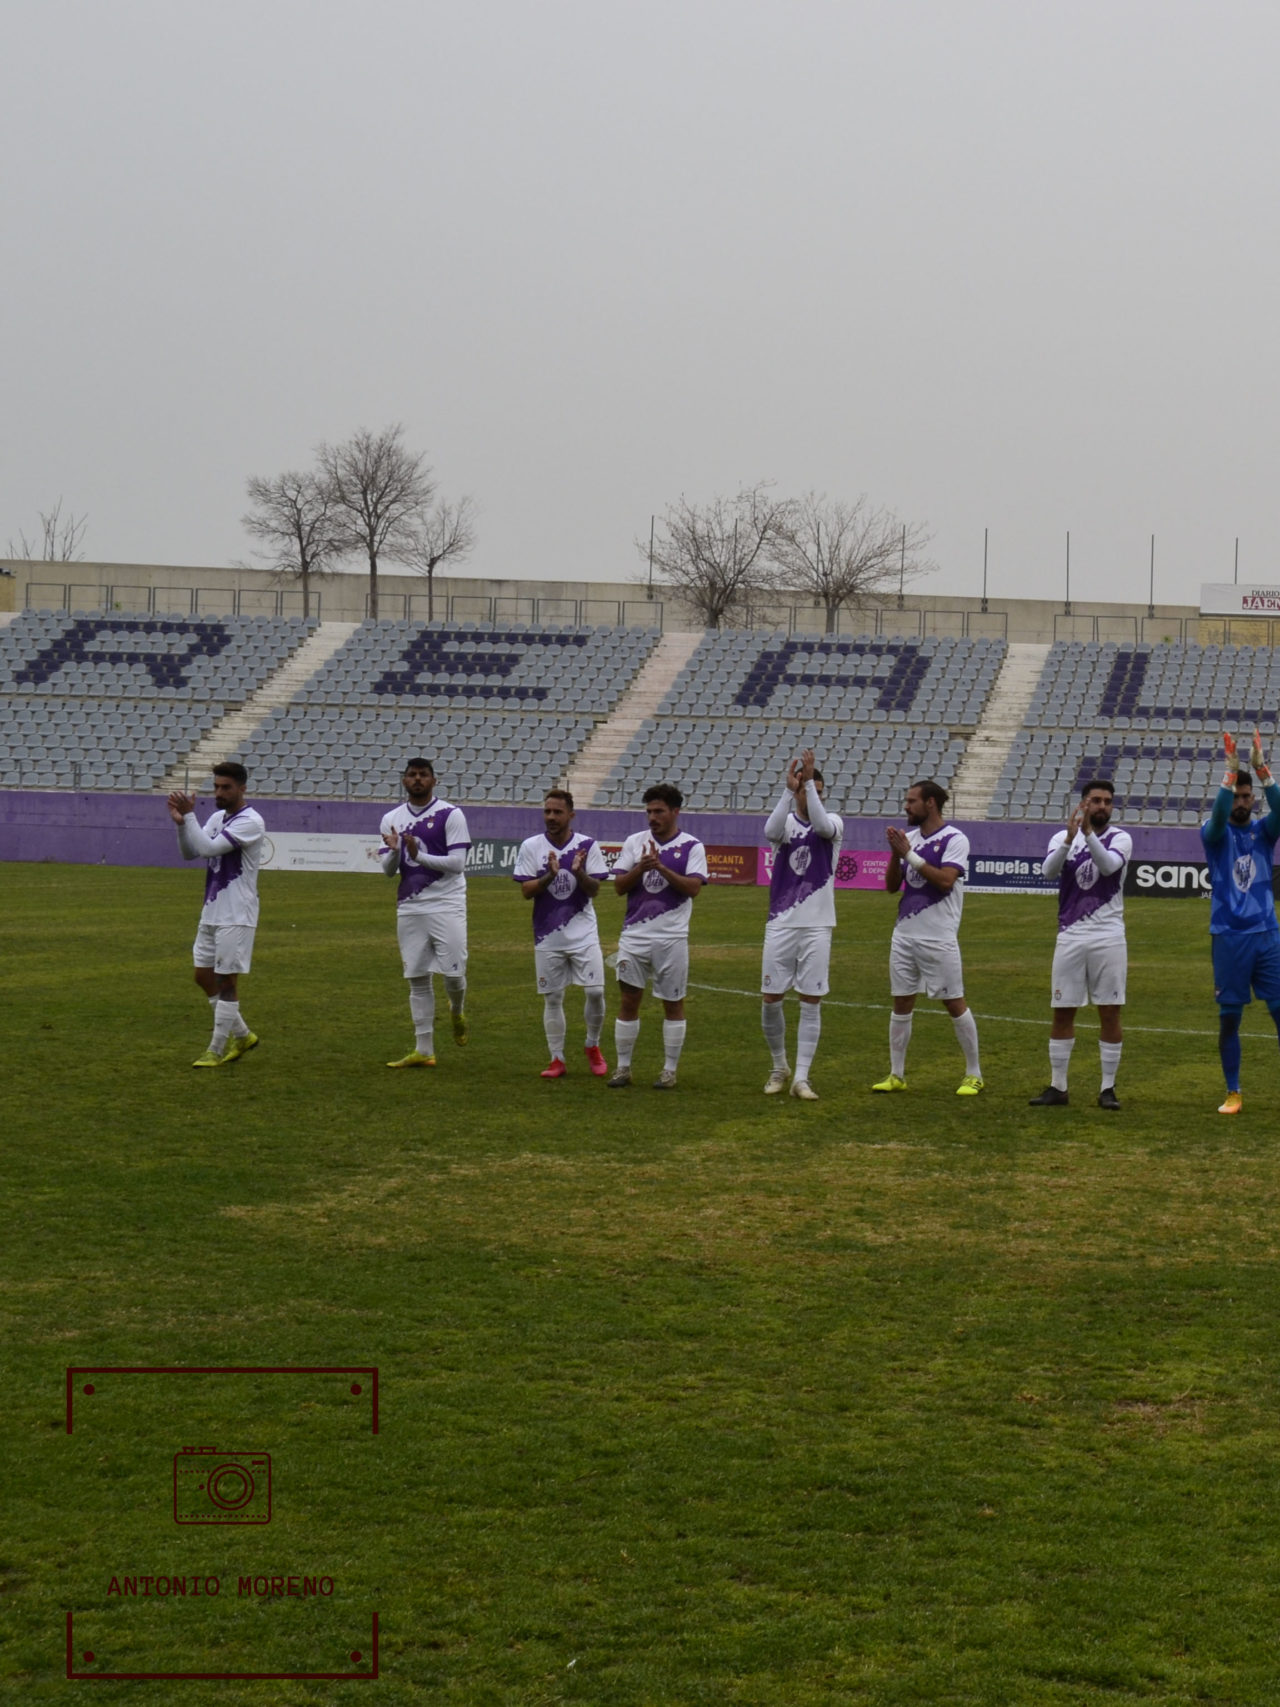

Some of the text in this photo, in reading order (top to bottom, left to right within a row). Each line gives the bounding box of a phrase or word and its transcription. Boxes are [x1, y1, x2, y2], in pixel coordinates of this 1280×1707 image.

[1251, 589, 1280, 598] DIARIO
[465, 842, 494, 866] AÉN
[707, 854, 744, 865] ENCANTA
[975, 859, 1030, 875] angela
